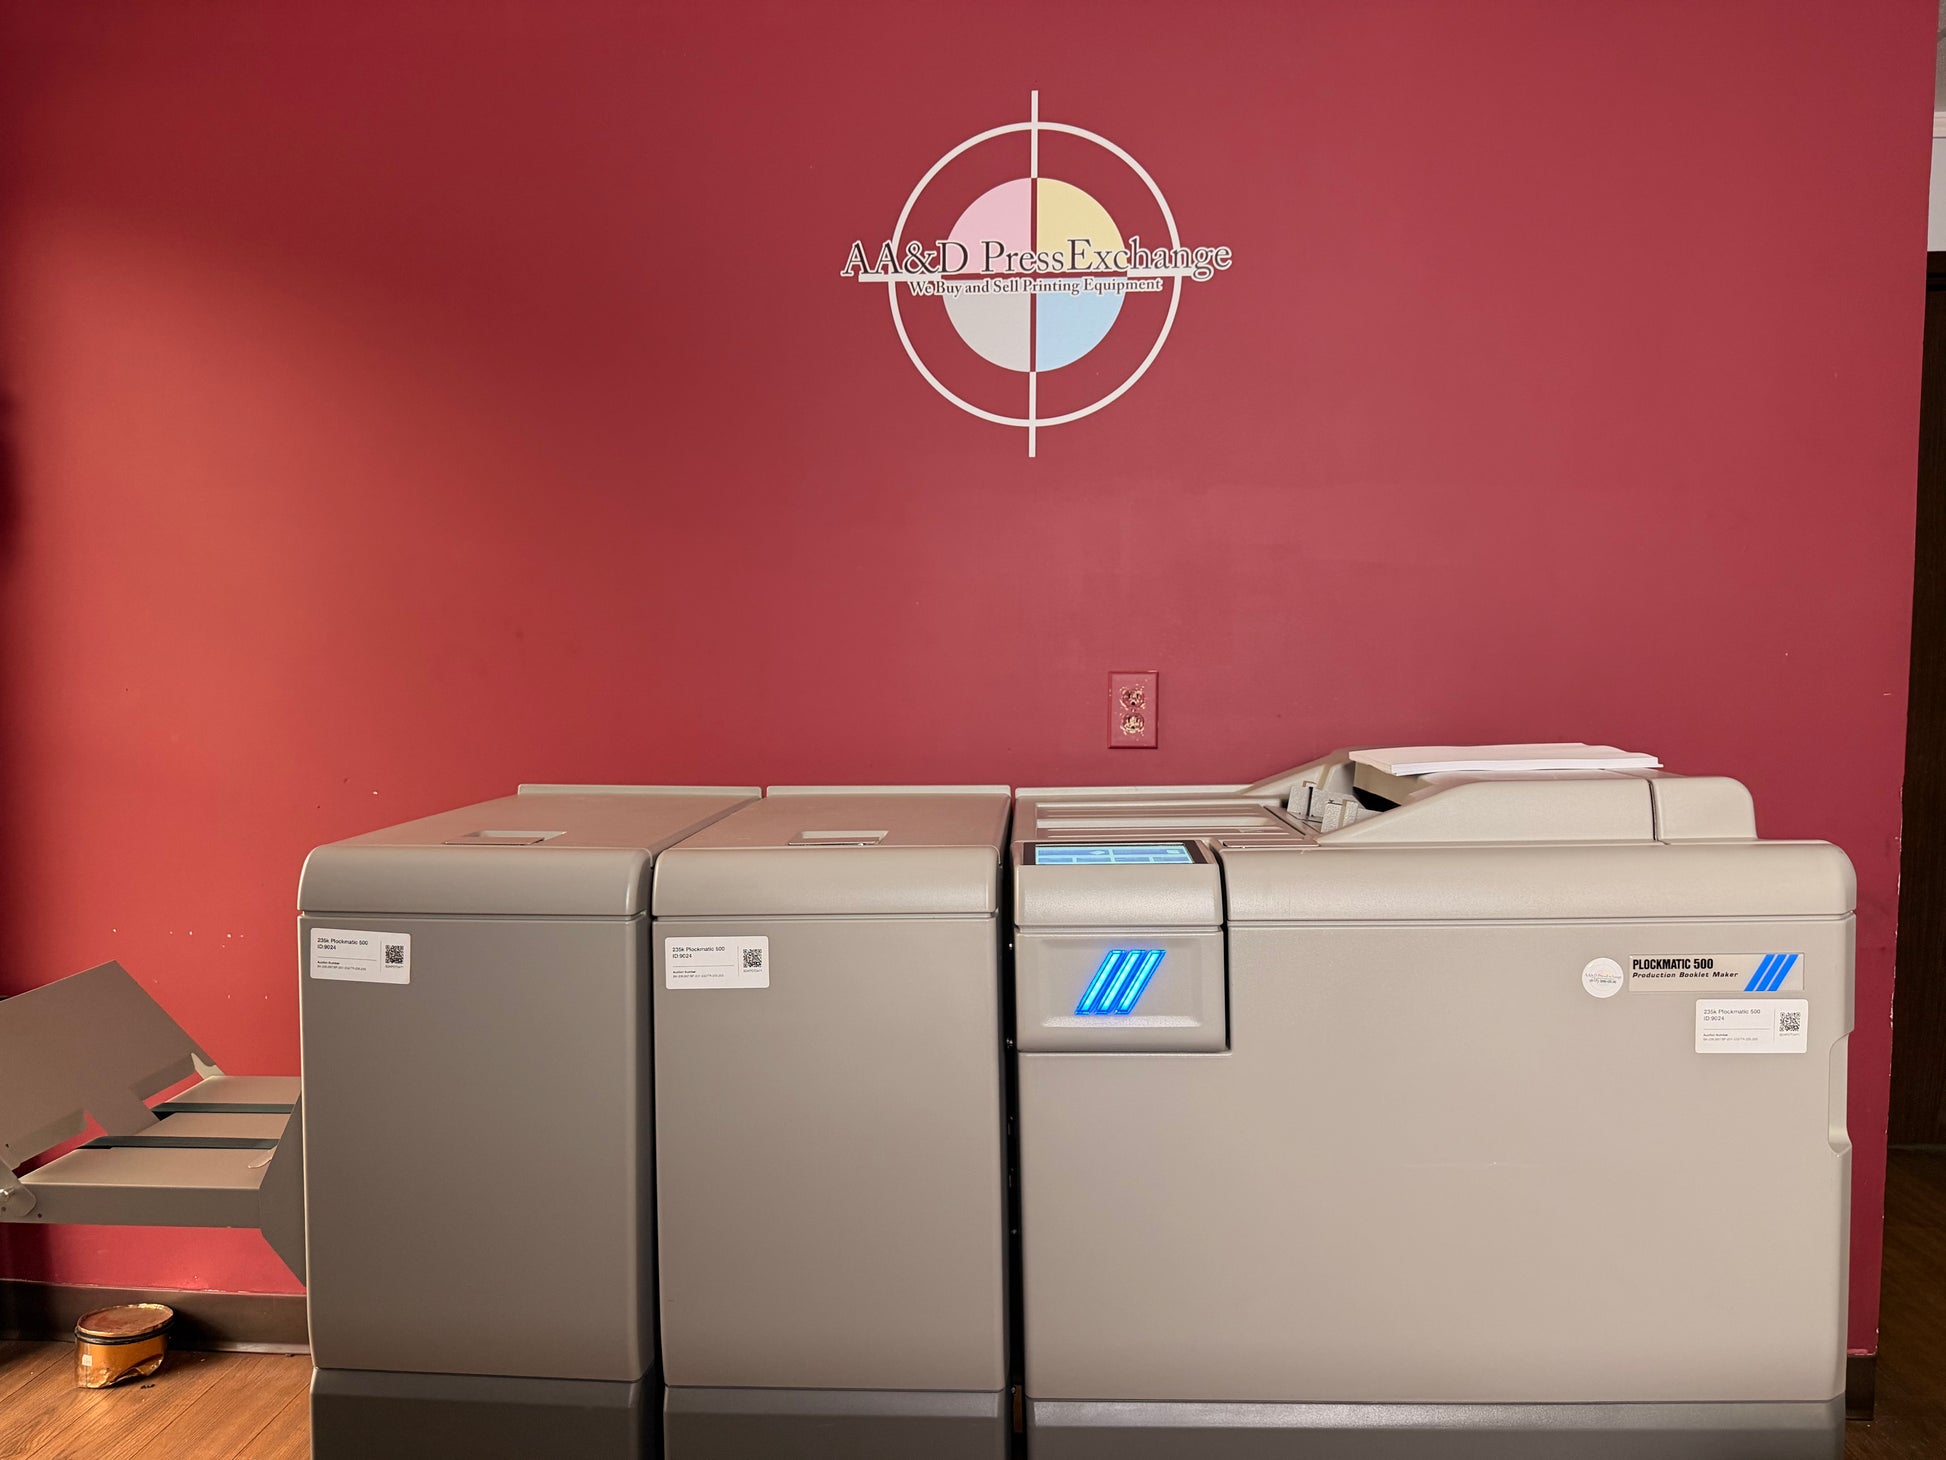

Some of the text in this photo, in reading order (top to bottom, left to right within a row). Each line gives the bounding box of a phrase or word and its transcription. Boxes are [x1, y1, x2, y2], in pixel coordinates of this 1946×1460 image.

[841, 237, 1230, 280] AA&D PressExchange
[909, 278, 1161, 297] We Buy and Sell Printing Equipment
[1632, 958, 1714, 970] PLOCKMATIC 500
